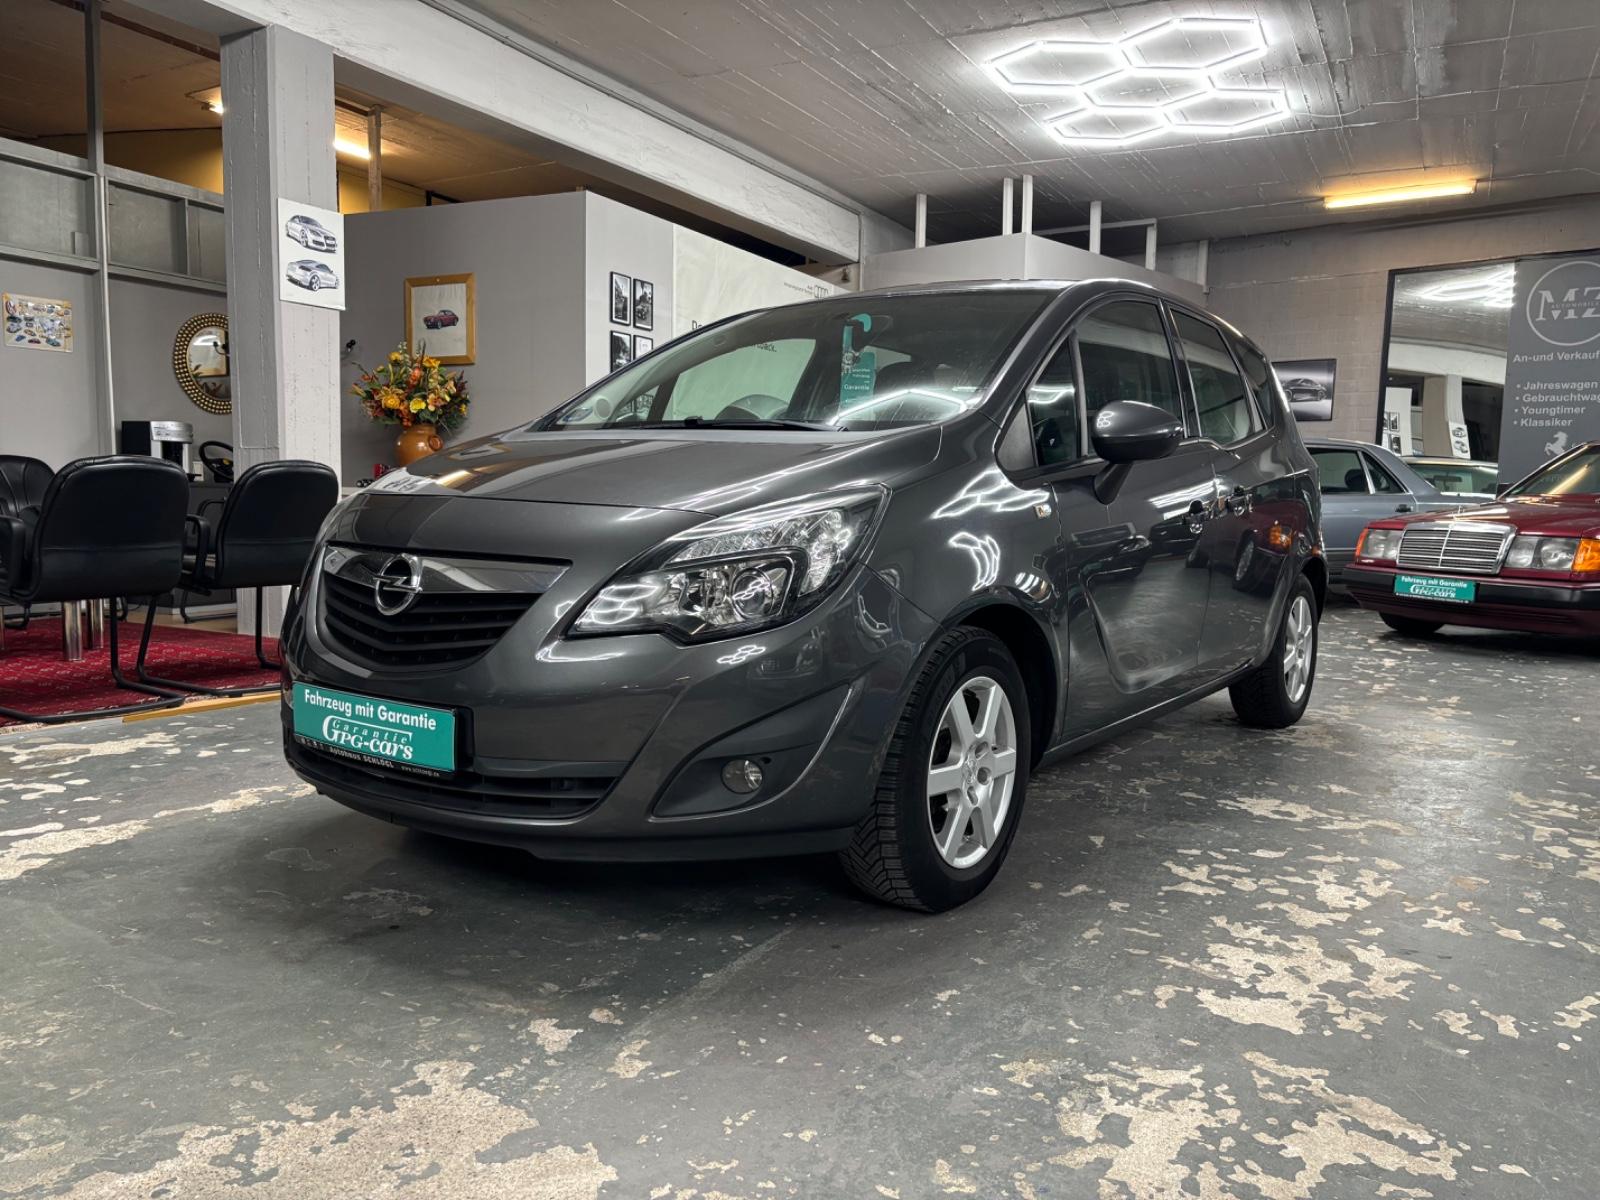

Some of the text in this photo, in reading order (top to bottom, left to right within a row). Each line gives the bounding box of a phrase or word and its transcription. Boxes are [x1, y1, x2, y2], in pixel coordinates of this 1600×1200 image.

[1523, 380, 1599, 392] Jahreswagen
[1521, 405, 1587, 417] Youngtimer
[1520, 417, 1574, 427] Klassiker
[1401, 575, 1427, 586] Fahrzeug
[1439, 579, 1468, 589] Garantie
[304, 688, 437, 731] Fahrzeug mit Garantie
[332, 718, 408, 745] Garantie
